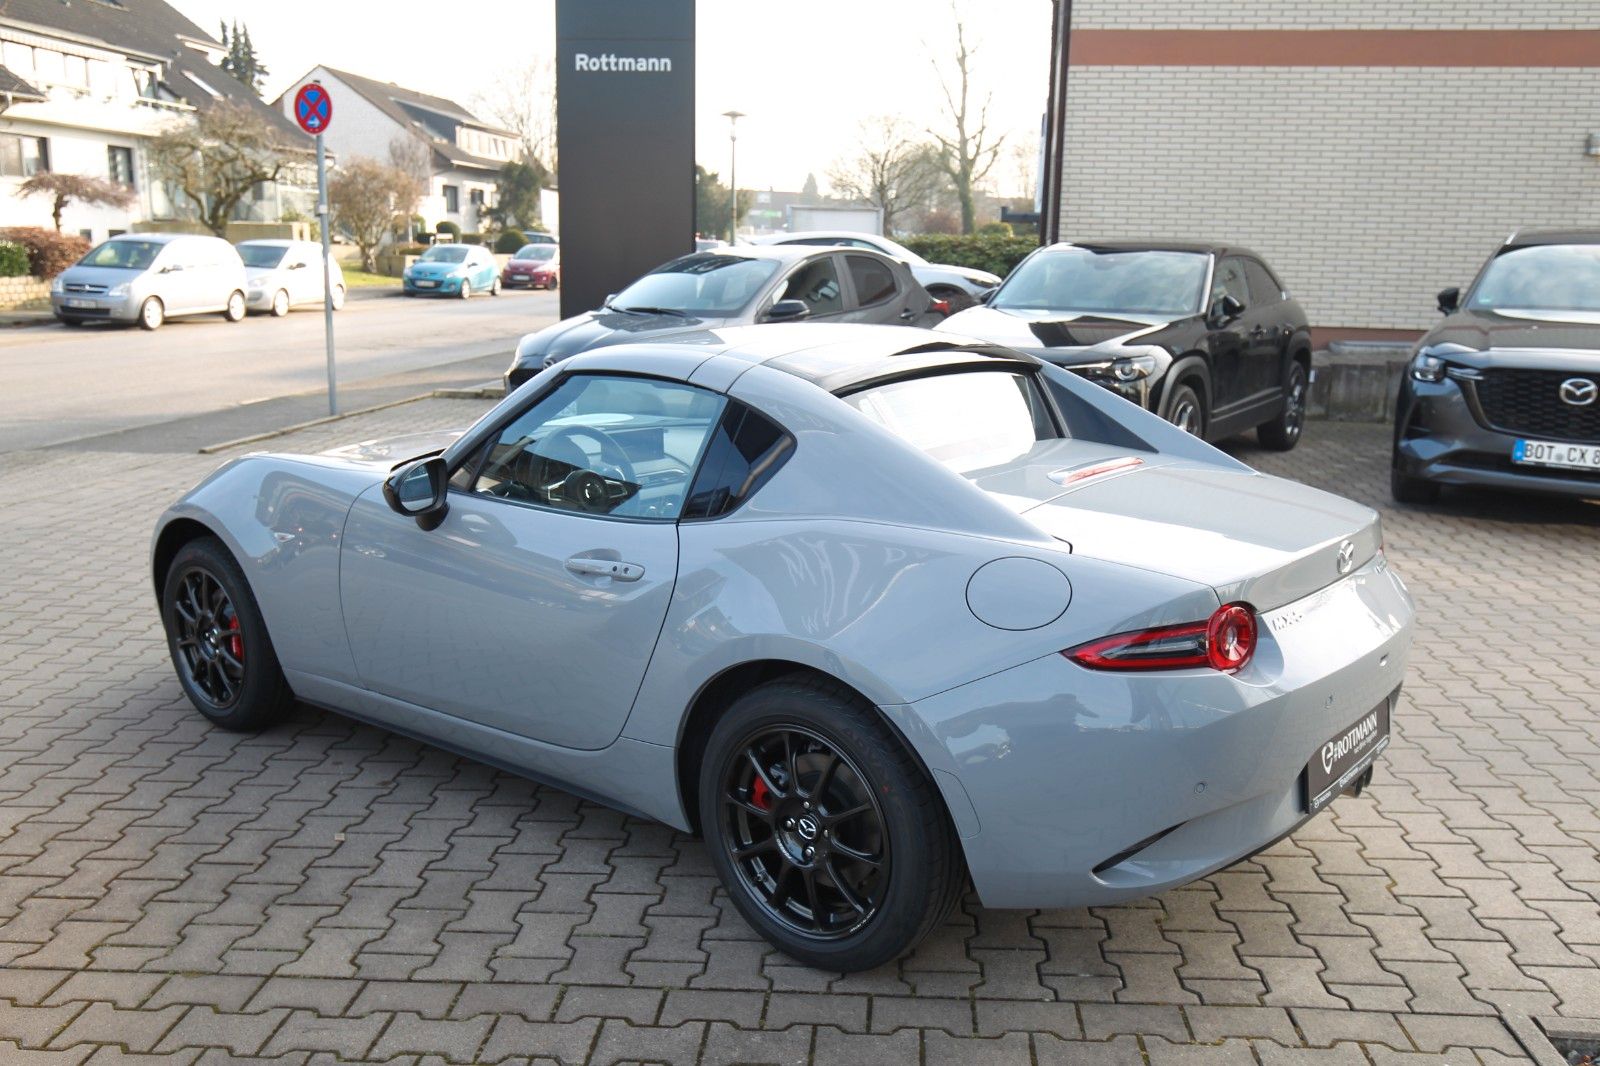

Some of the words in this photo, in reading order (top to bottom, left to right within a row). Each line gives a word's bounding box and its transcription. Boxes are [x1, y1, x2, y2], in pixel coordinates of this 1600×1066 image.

[575, 53, 672, 71] Rottmann
[1525, 443, 1555, 460] BOT
[1568, 447, 1588, 464] CX
